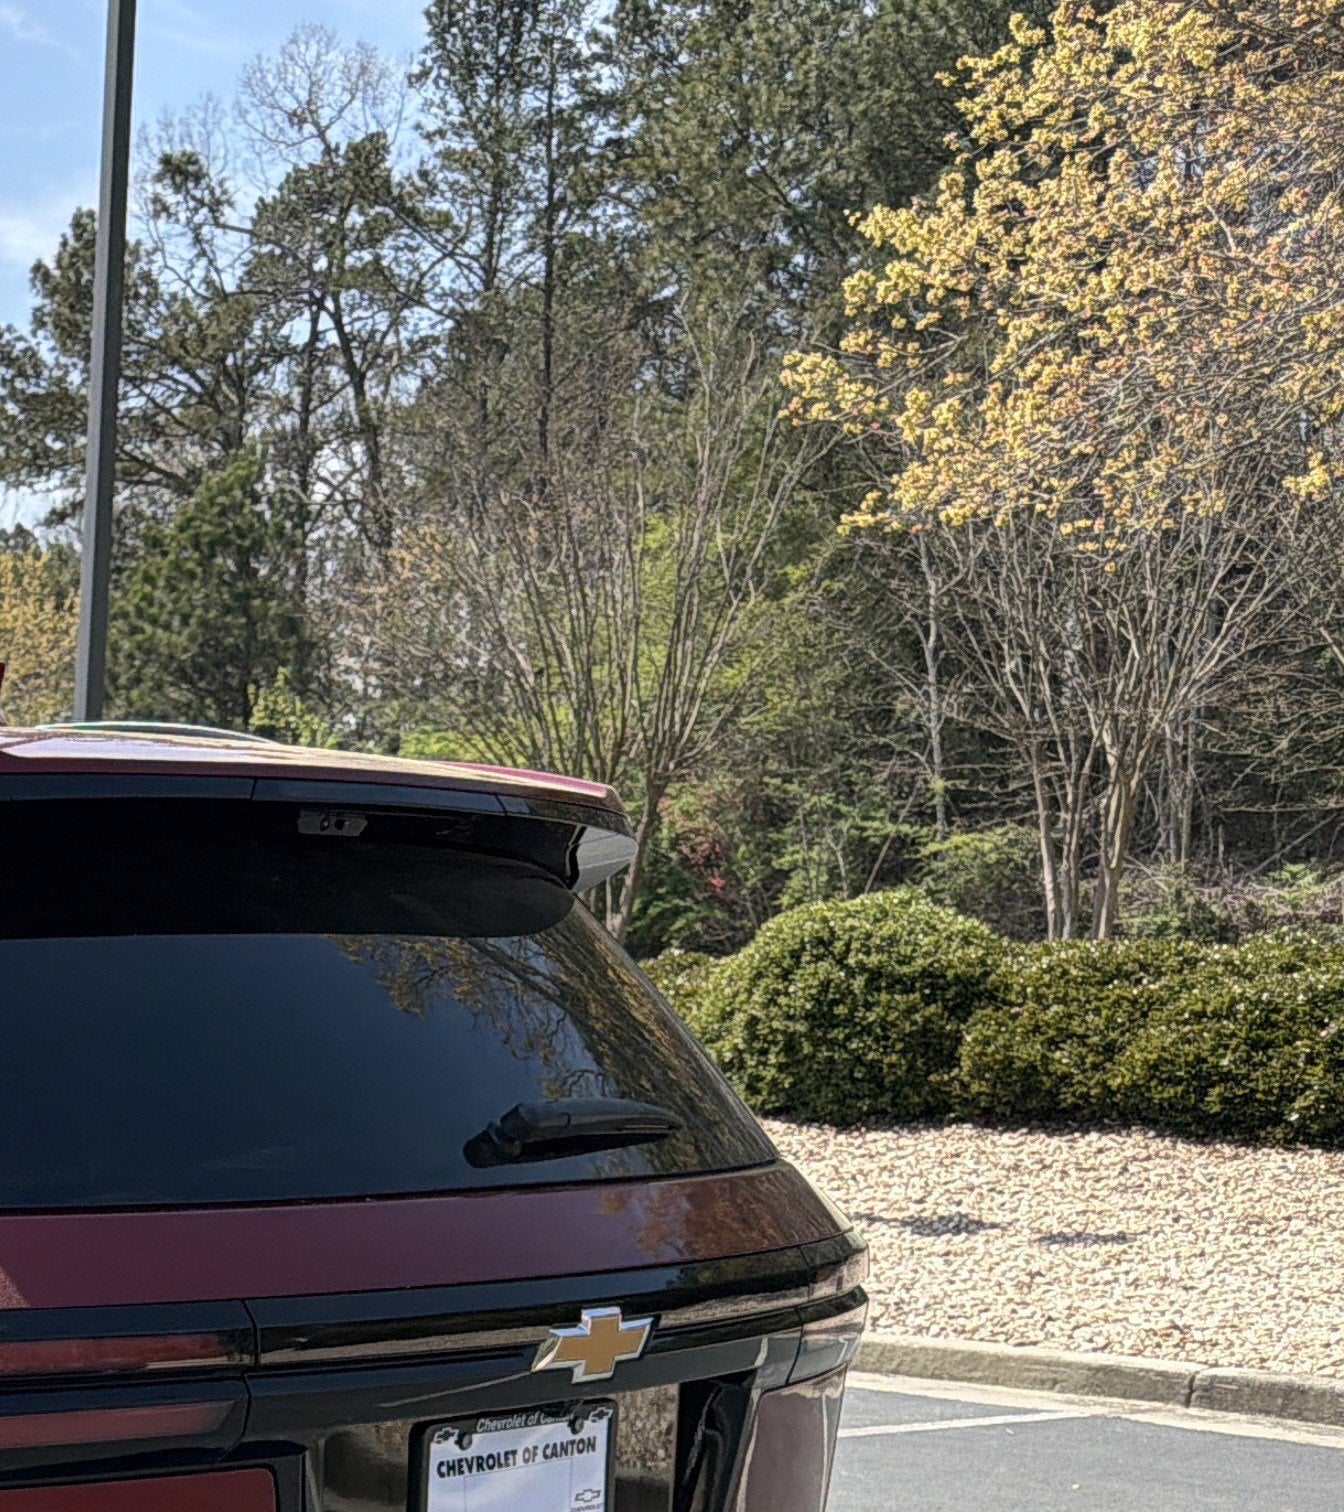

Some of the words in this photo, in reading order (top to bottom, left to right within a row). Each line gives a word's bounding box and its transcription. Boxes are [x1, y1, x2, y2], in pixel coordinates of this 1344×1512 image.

[476, 1414, 525, 1433] Chevrolet
[437, 1449, 518, 1479] CHEVROLET
[522, 1448, 539, 1464] OF
[542, 1436, 596, 1460] CANTON
